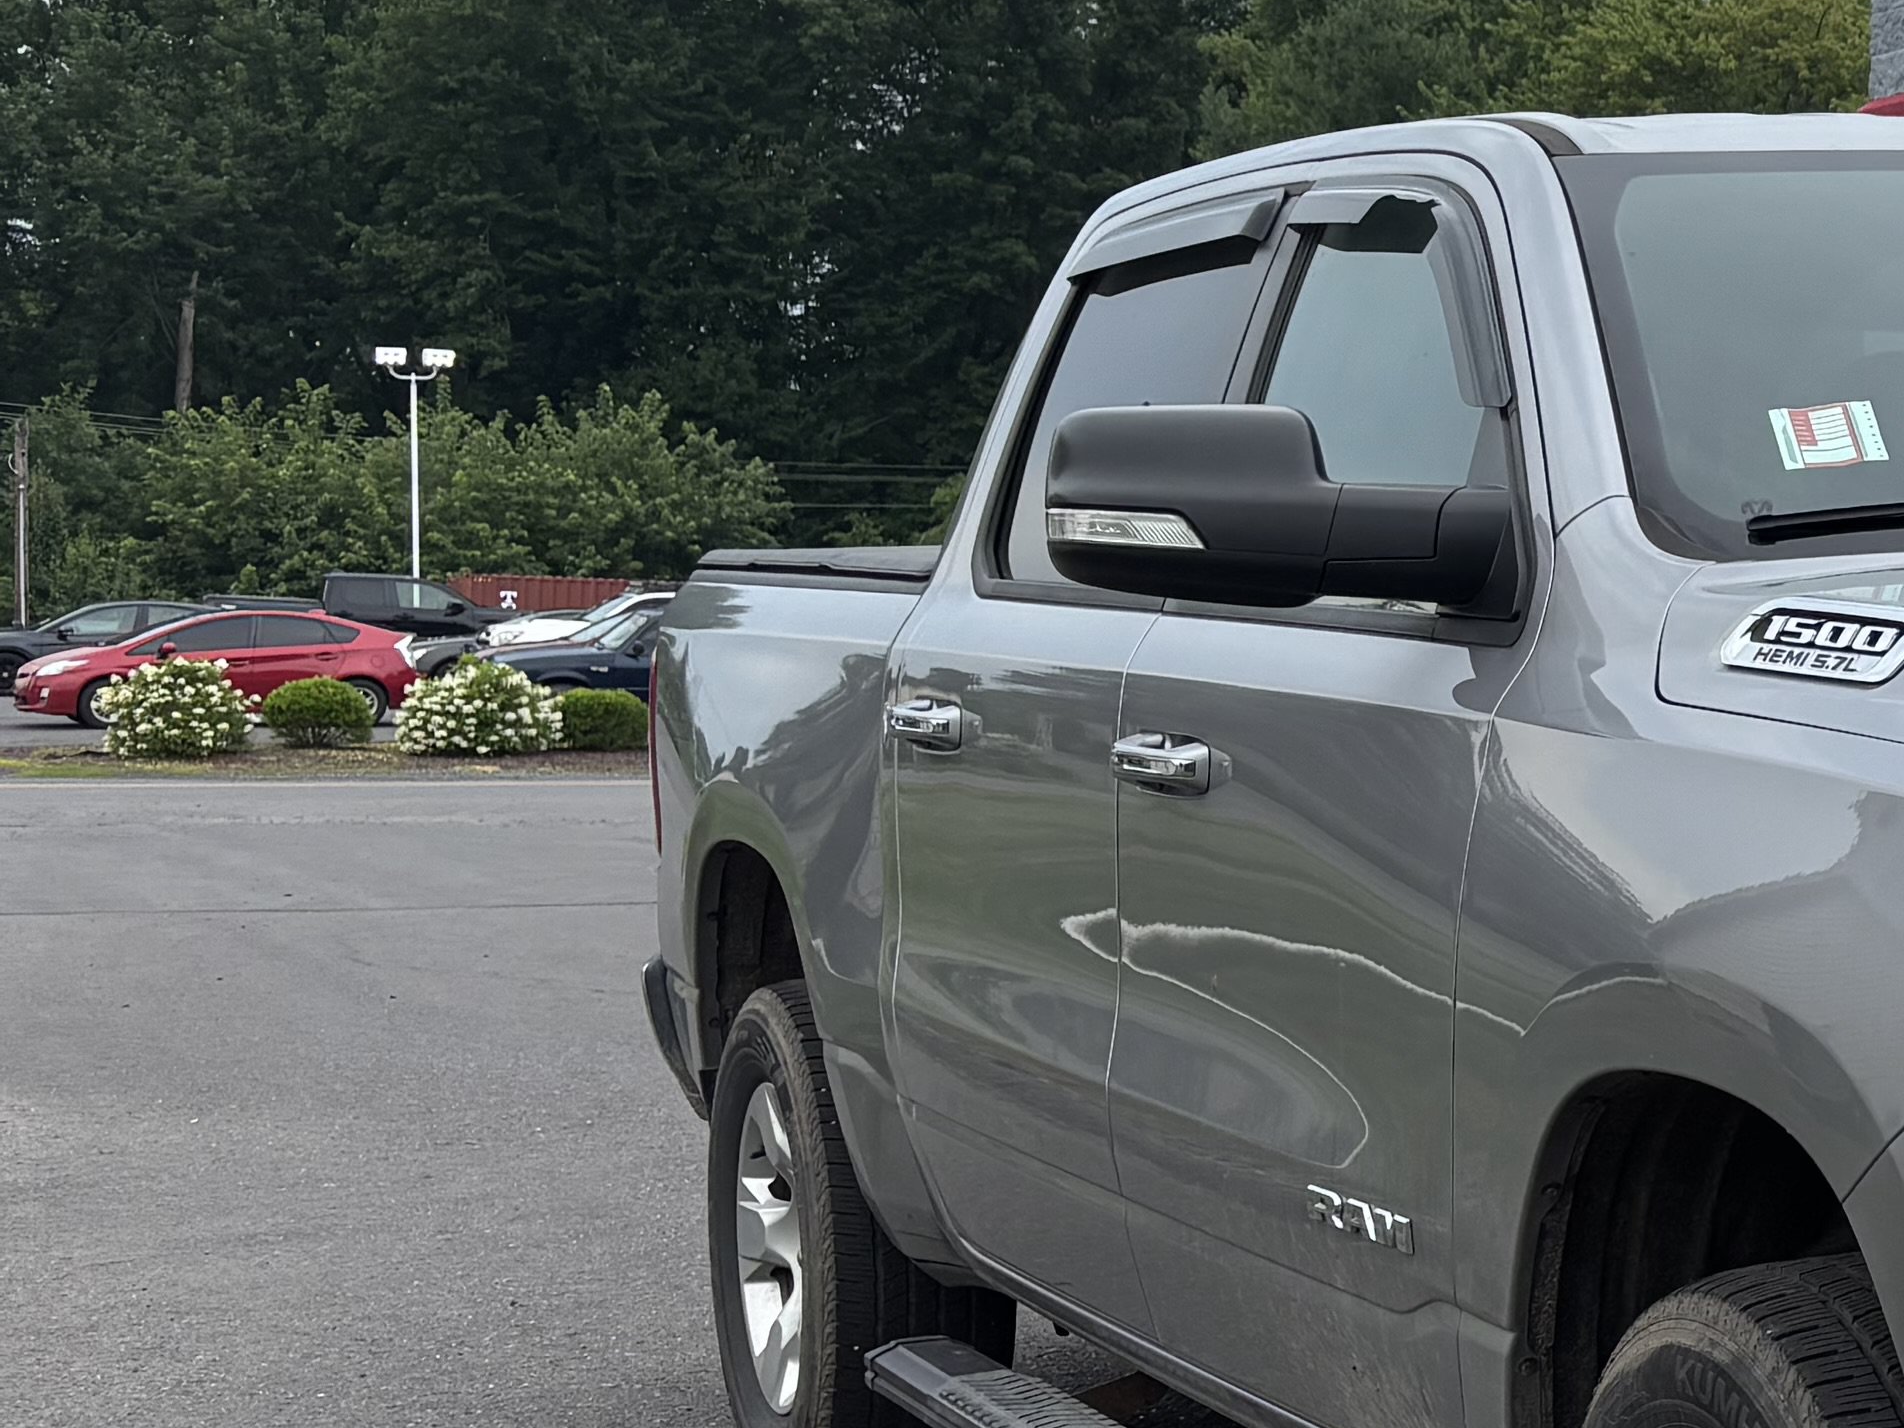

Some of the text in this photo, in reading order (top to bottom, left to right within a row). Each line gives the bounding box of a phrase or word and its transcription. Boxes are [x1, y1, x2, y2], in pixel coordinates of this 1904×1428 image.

[1763, 615, 1899, 652] 1500
[1753, 646, 1859, 673] HEMI 5.7L
